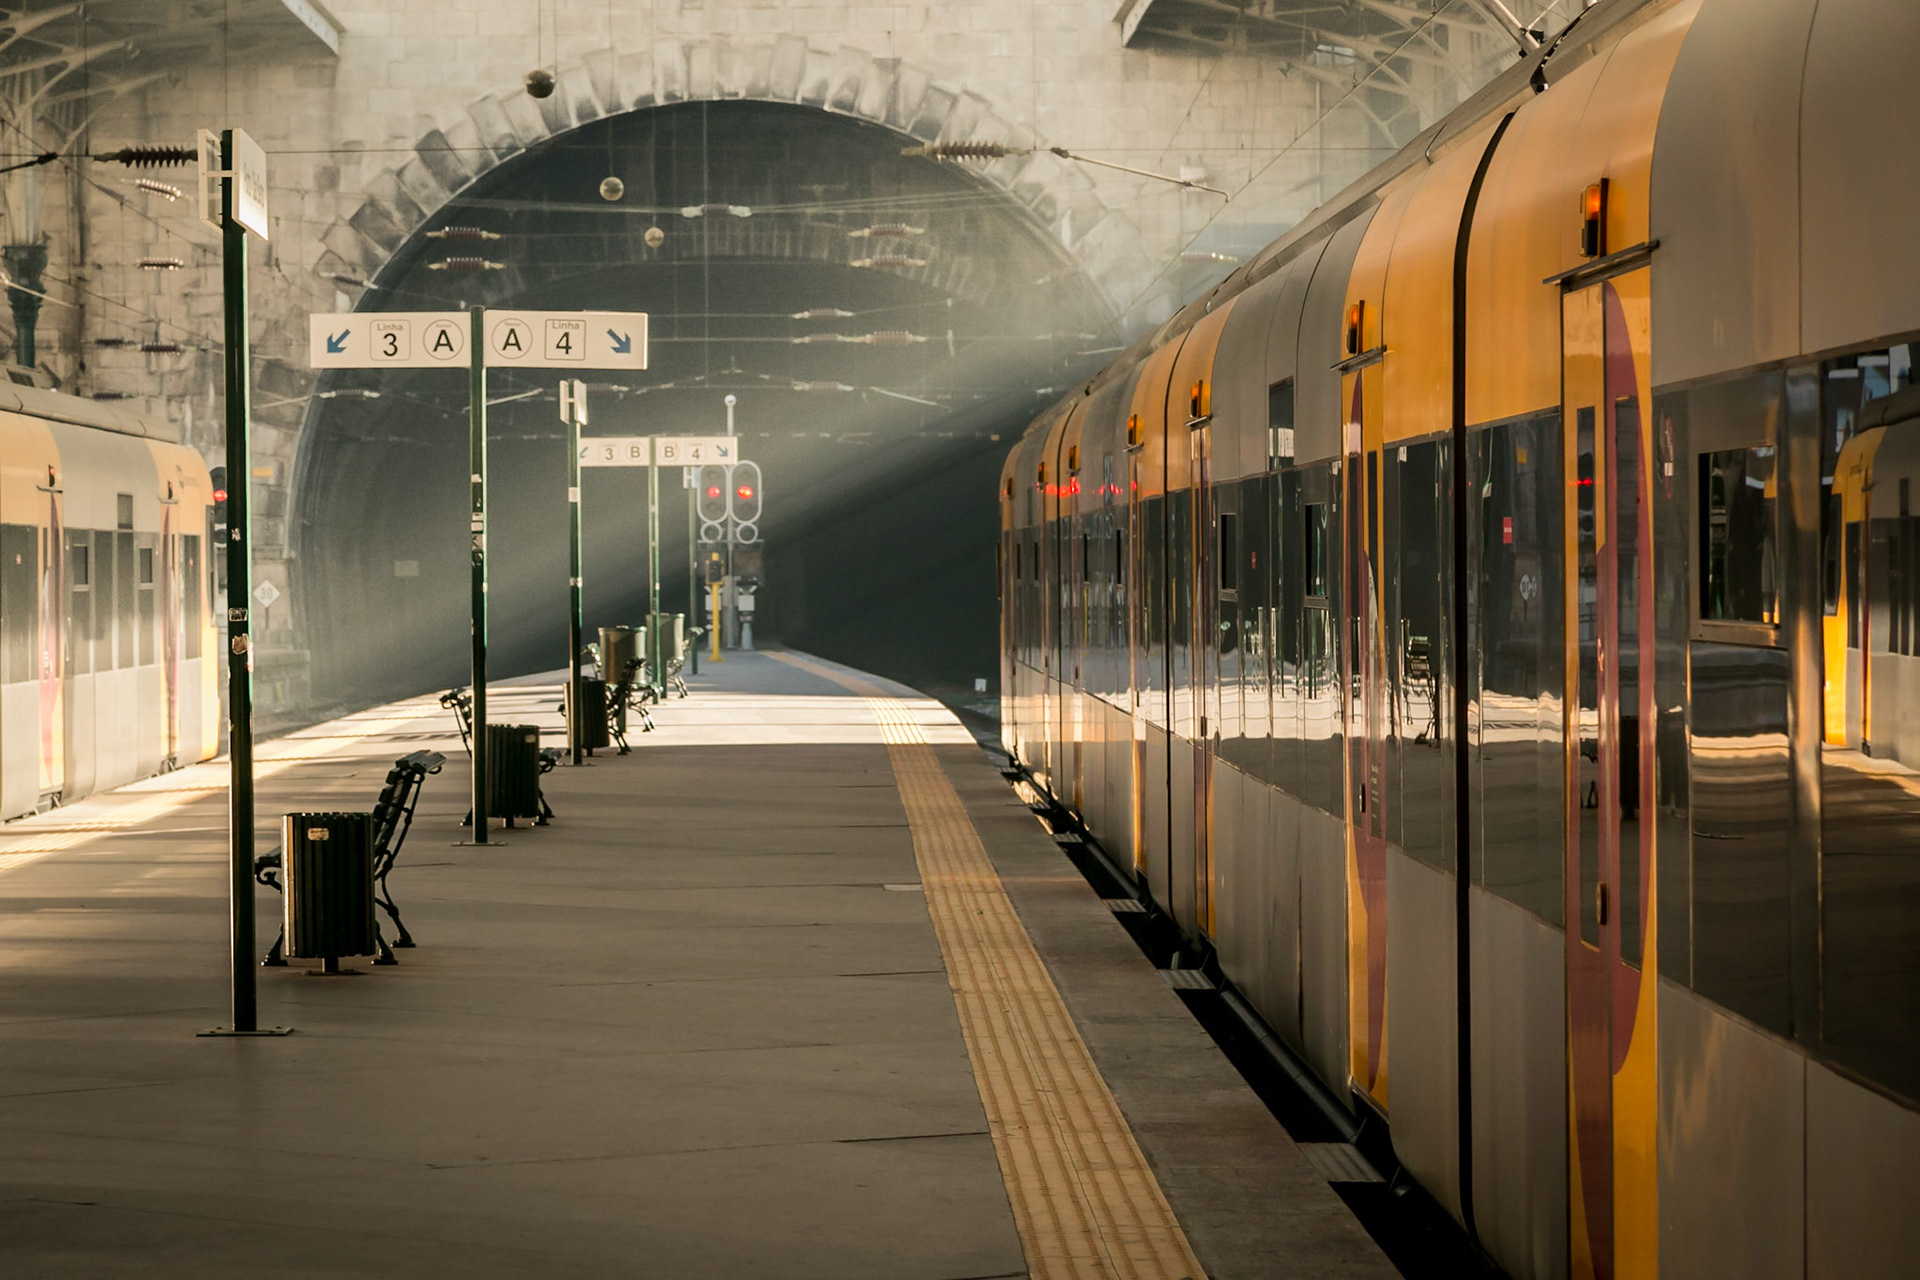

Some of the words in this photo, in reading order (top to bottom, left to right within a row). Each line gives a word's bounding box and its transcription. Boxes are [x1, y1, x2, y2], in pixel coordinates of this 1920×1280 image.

[377, 323, 404, 331] Linha
[552, 321, 580, 330] Linha
[383, 333, 398, 357] 3
[433, 329, 454, 352] A
[502, 328, 522, 351] A
[556, 332, 572, 355] 4
[605, 448, 614, 460] 3
[630, 446, 640, 458] B
[664, 446, 675, 458] B
[691, 448, 700, 460] 4
